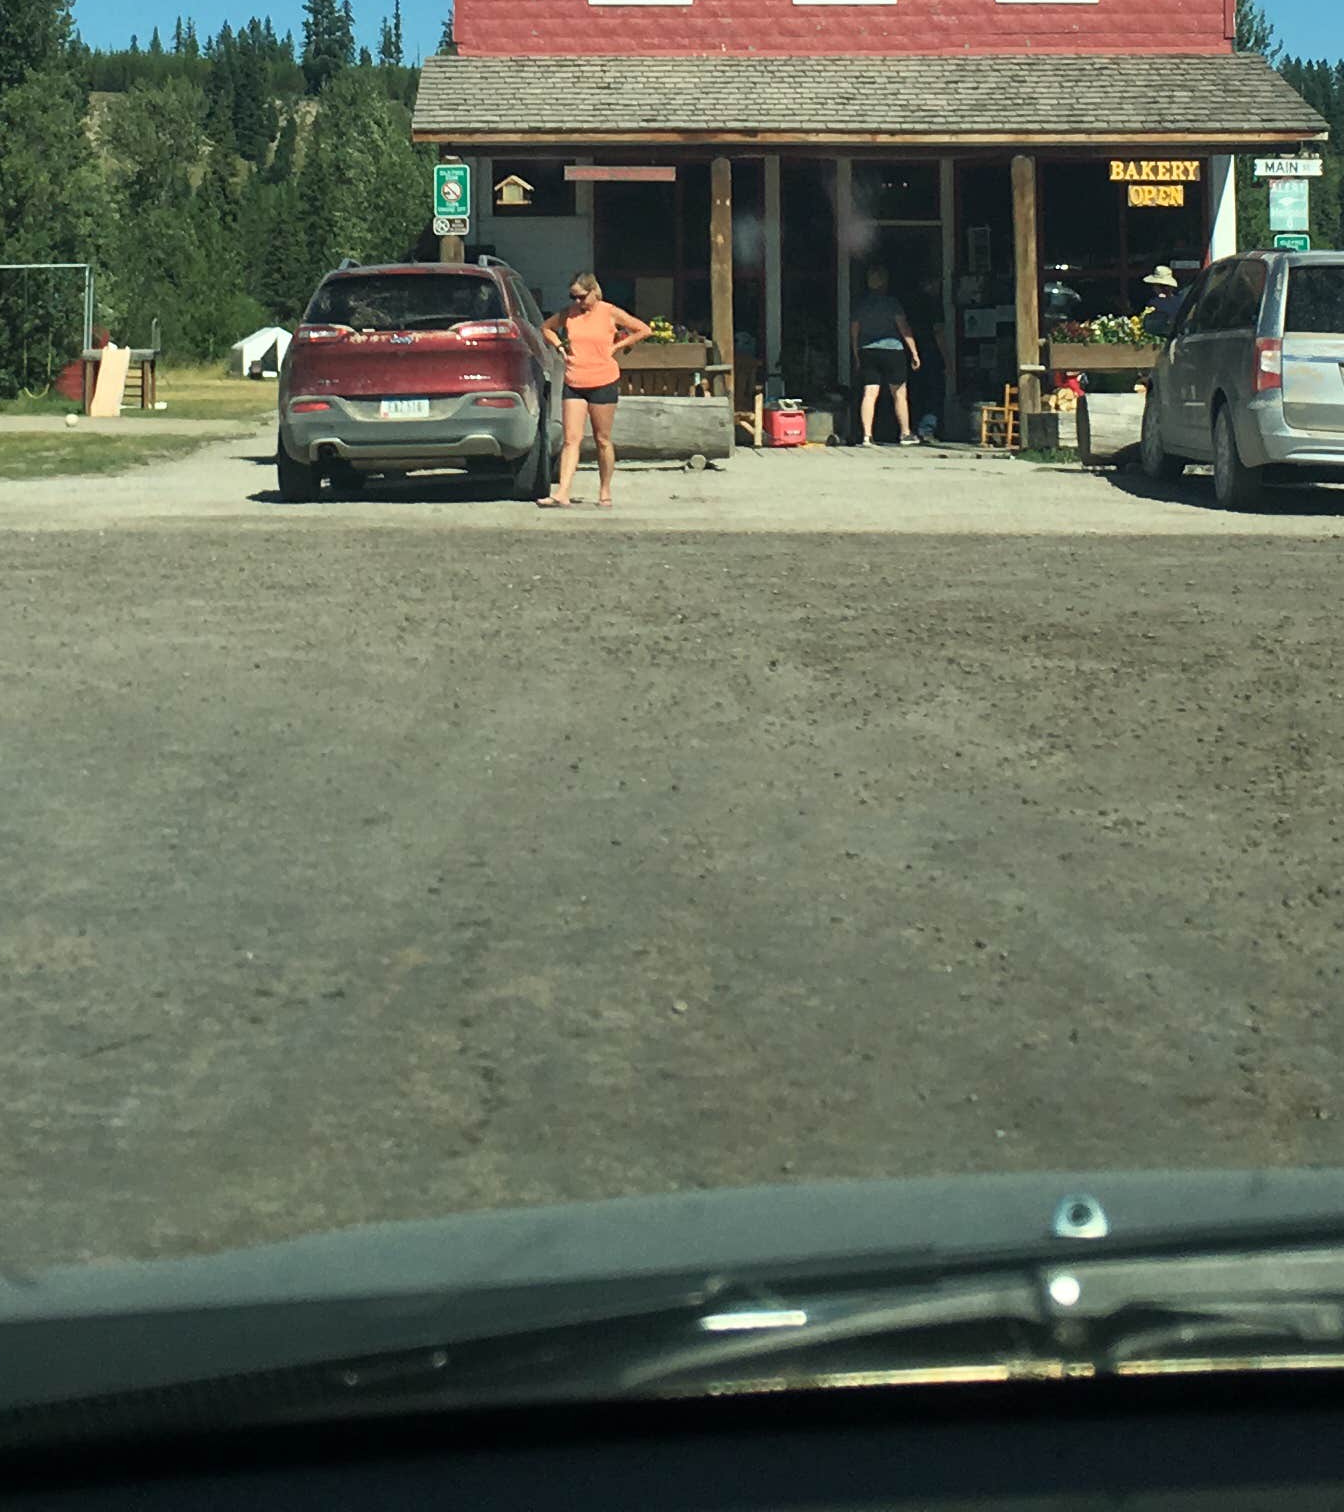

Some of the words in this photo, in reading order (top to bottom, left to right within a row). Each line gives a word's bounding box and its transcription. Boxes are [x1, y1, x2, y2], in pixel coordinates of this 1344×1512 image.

[1109, 160, 1200, 181] BAKERY
[1264, 161, 1299, 174] MAIN
[1129, 185, 1184, 207] OPEN
